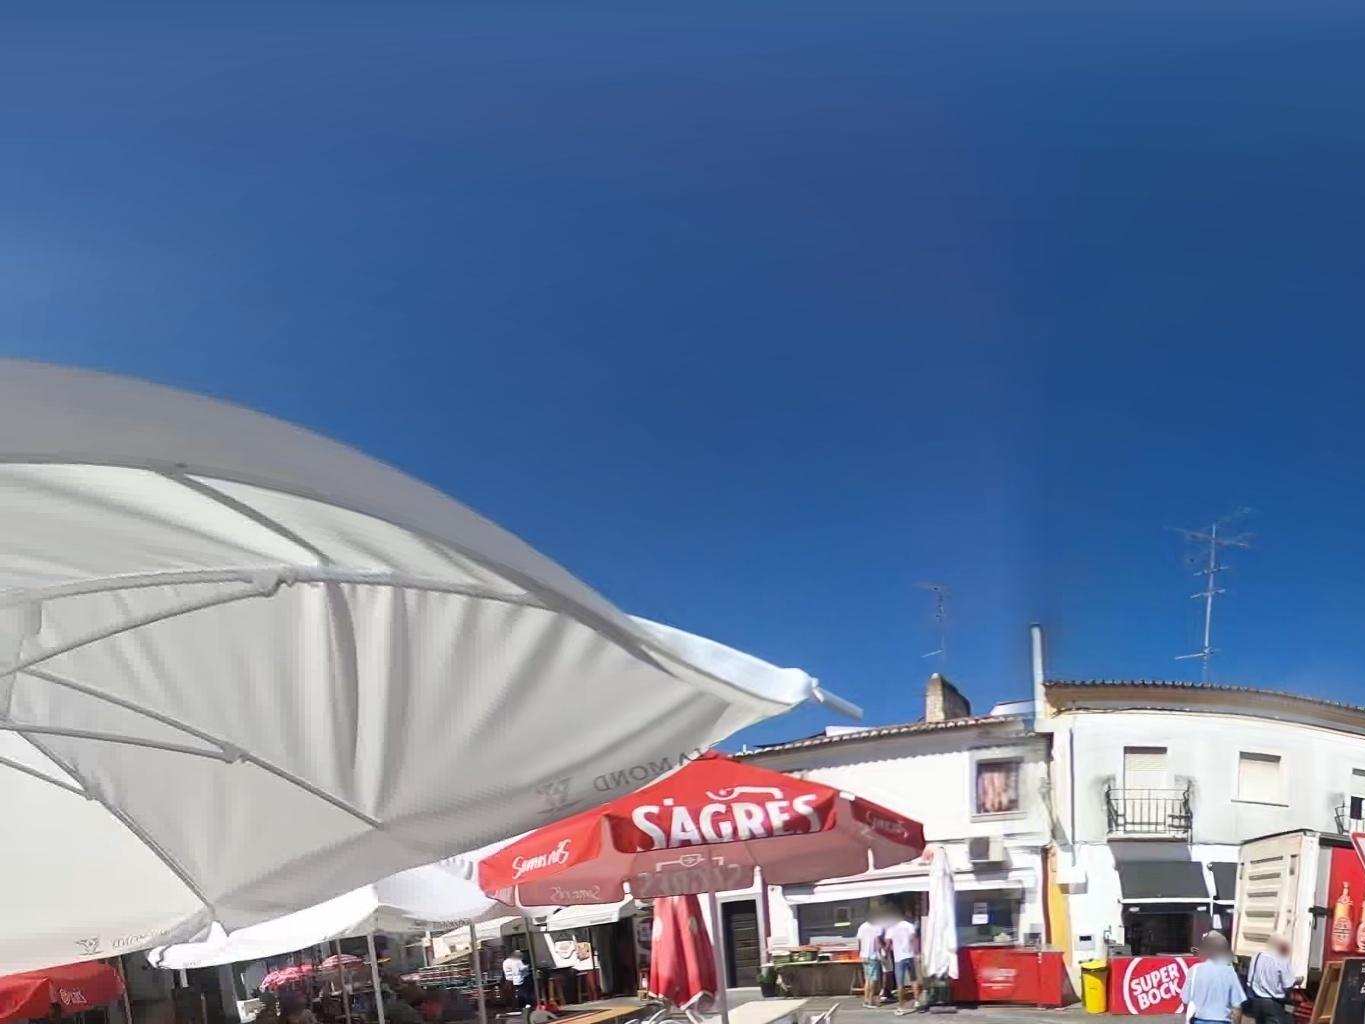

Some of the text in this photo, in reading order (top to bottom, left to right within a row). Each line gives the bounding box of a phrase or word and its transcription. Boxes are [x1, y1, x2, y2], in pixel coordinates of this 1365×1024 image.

[632, 794, 821, 852] SAGRES
[1131, 963, 1180, 996] SUPER
[1137, 978, 1182, 1010] BOCK
